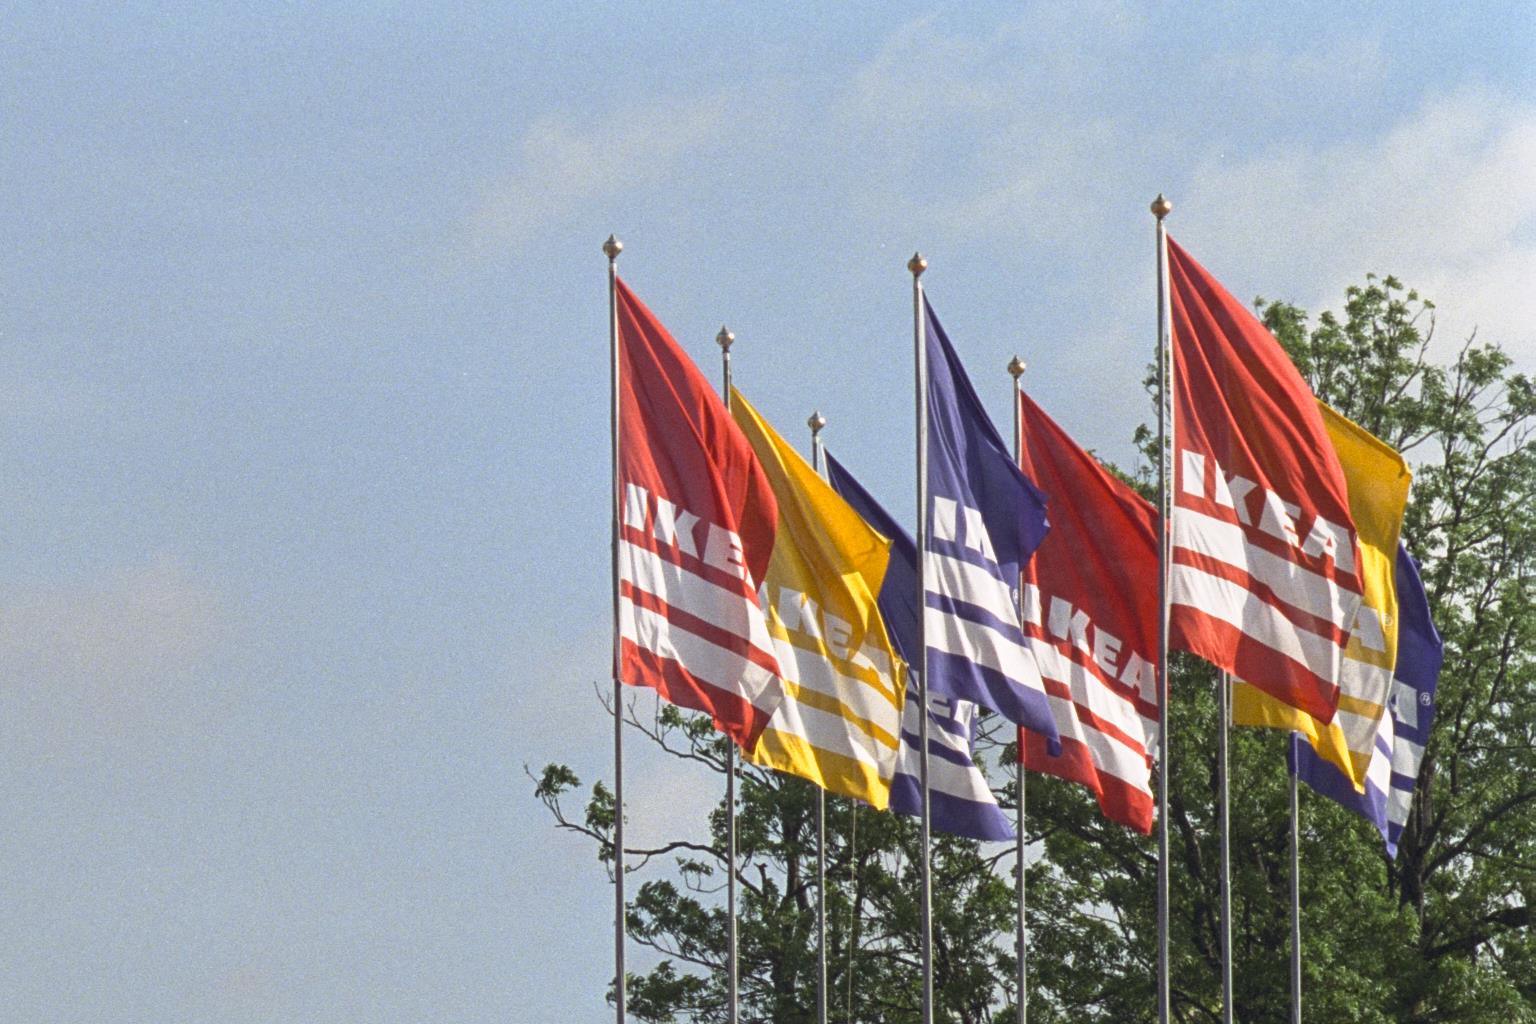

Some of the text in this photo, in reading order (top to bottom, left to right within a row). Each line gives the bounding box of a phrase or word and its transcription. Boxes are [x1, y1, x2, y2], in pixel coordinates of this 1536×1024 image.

[623, 483, 748, 582] IKE
[1182, 448, 1357, 575] IKEA
[1023, 585, 1159, 706] IKEA
